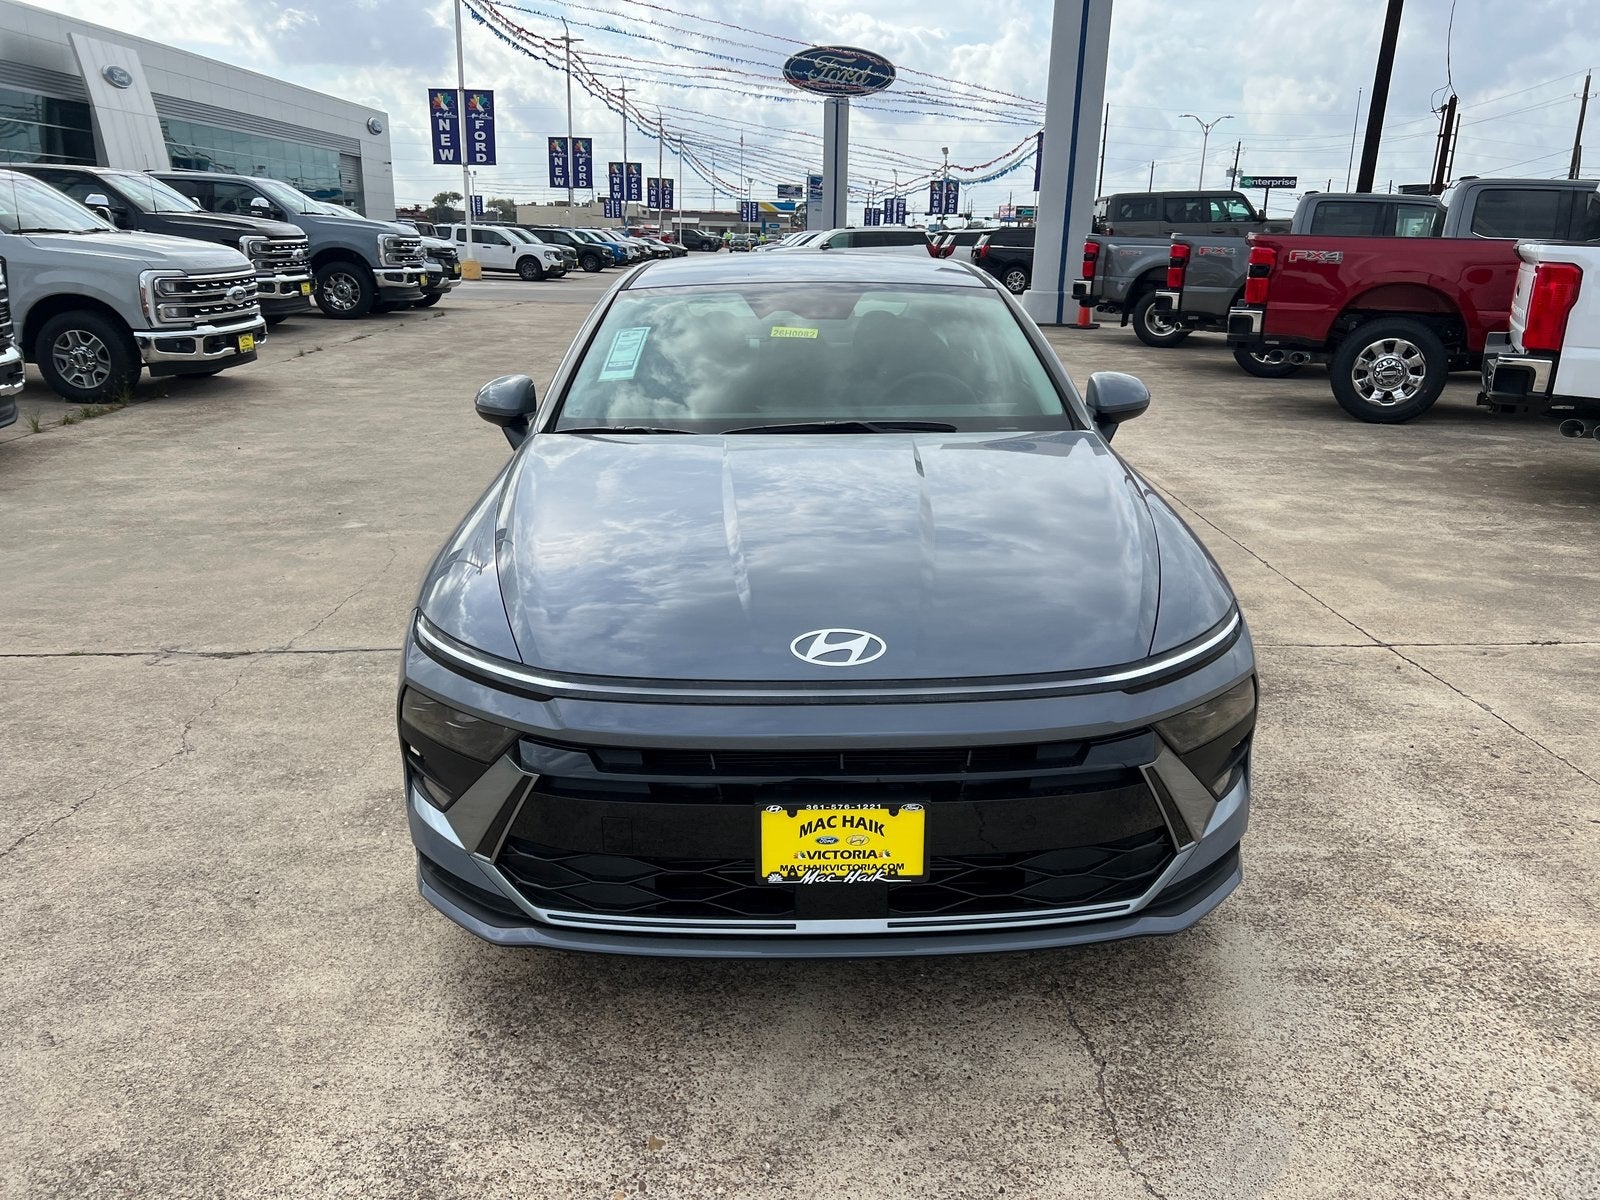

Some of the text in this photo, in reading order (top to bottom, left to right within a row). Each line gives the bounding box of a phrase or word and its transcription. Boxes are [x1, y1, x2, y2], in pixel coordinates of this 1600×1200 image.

[808, 55, 872, 85] Ford
[438, 119, 454, 161] NEW
[474, 120, 487, 163] FORD
[553, 157, 564, 186] NEW
[578, 158, 587, 187] FORD
[613, 177, 621, 199] NEW
[1243, 178, 1296, 187] enterprise
[649, 190, 657, 208] NEW
[932, 193, 940, 213] NEW
[948, 194, 956, 213] FORD
[1288, 250, 1343, 262] FX4
[800, 815, 885, 838] MAC HAIK
[806, 849, 878, 860] VICTORIA
[800, 868, 887, 884] Mac Haik
